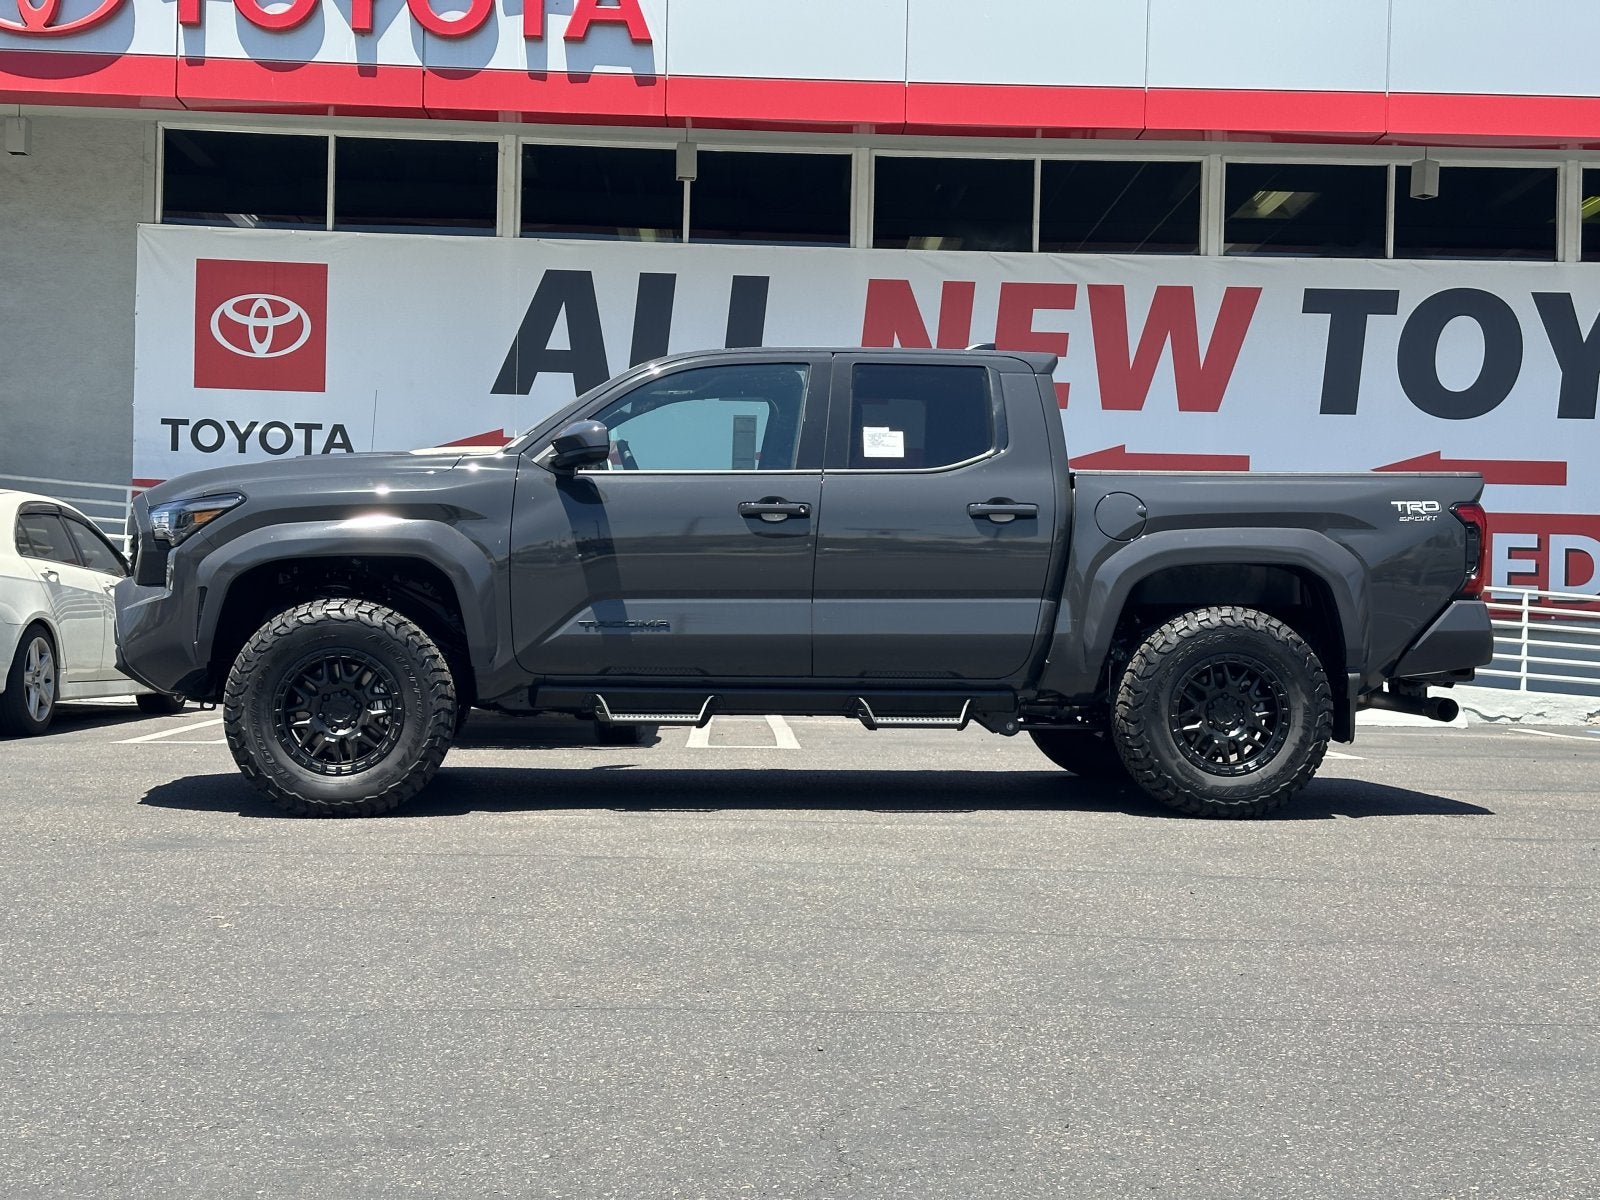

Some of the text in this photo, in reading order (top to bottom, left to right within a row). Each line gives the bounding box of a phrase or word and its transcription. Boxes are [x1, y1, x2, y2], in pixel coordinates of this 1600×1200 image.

[861, 279, 1263, 412] NEW
[160, 418, 355, 456] TOYOTA
[1391, 500, 1441, 515] TRD
